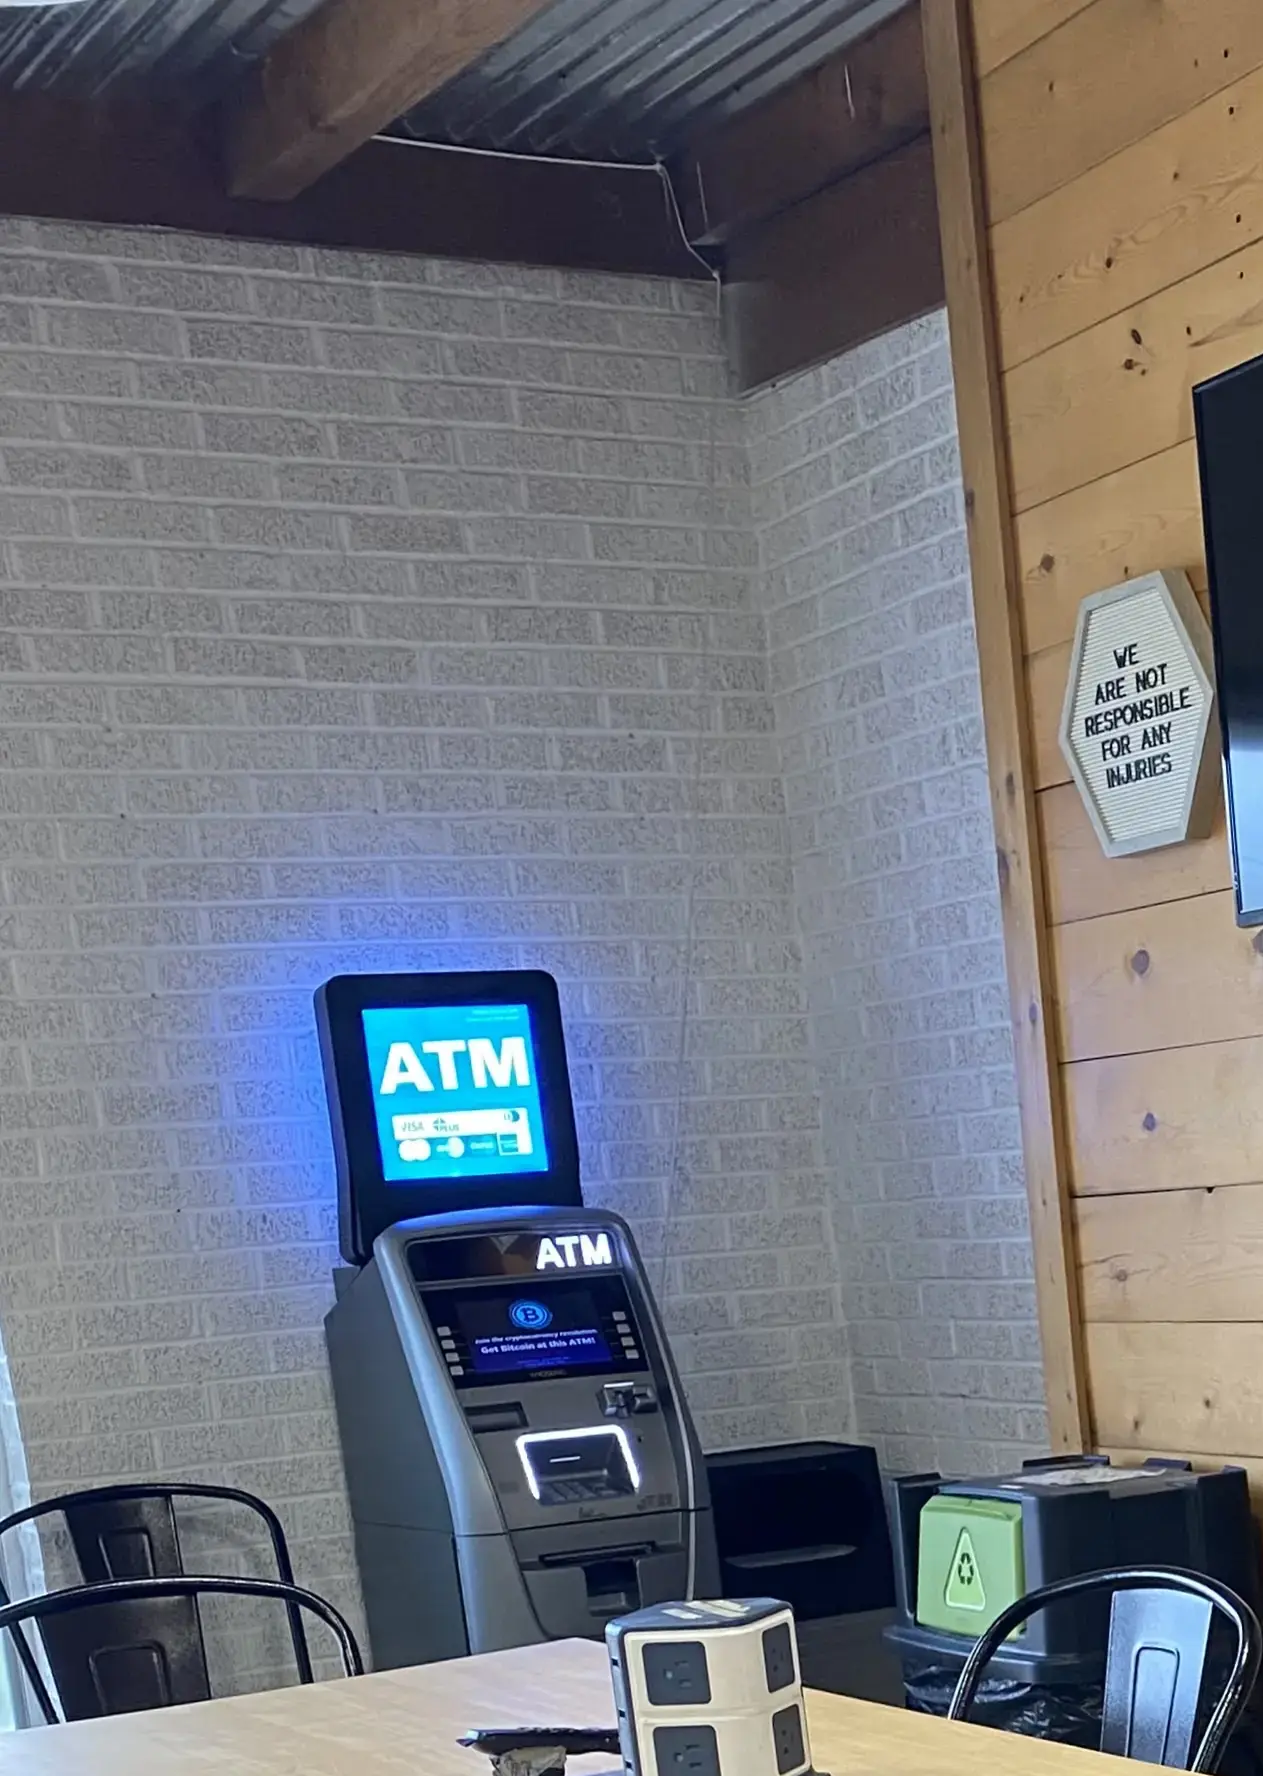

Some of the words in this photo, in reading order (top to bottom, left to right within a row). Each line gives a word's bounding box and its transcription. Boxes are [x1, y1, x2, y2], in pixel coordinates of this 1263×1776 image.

[1113, 643, 1140, 669] WE
[1094, 678, 1126, 706] ARE
[1135, 664, 1168, 693] NOT
[1084, 687, 1193, 737] RESPONSIBLE
[1101, 736, 1131, 761] FOR
[1140, 721, 1173, 750] ANY
[1106, 752, 1173, 789] INJURIES
[379, 1036, 531, 1095] ATM
[536, 1233, 613, 1270] ATM
[480, 1344, 499, 1354] Get
[500, 1343, 536, 1353] Bitcoin
[536, 1341, 548, 1349] at
[548, 1339, 567, 1348] this
